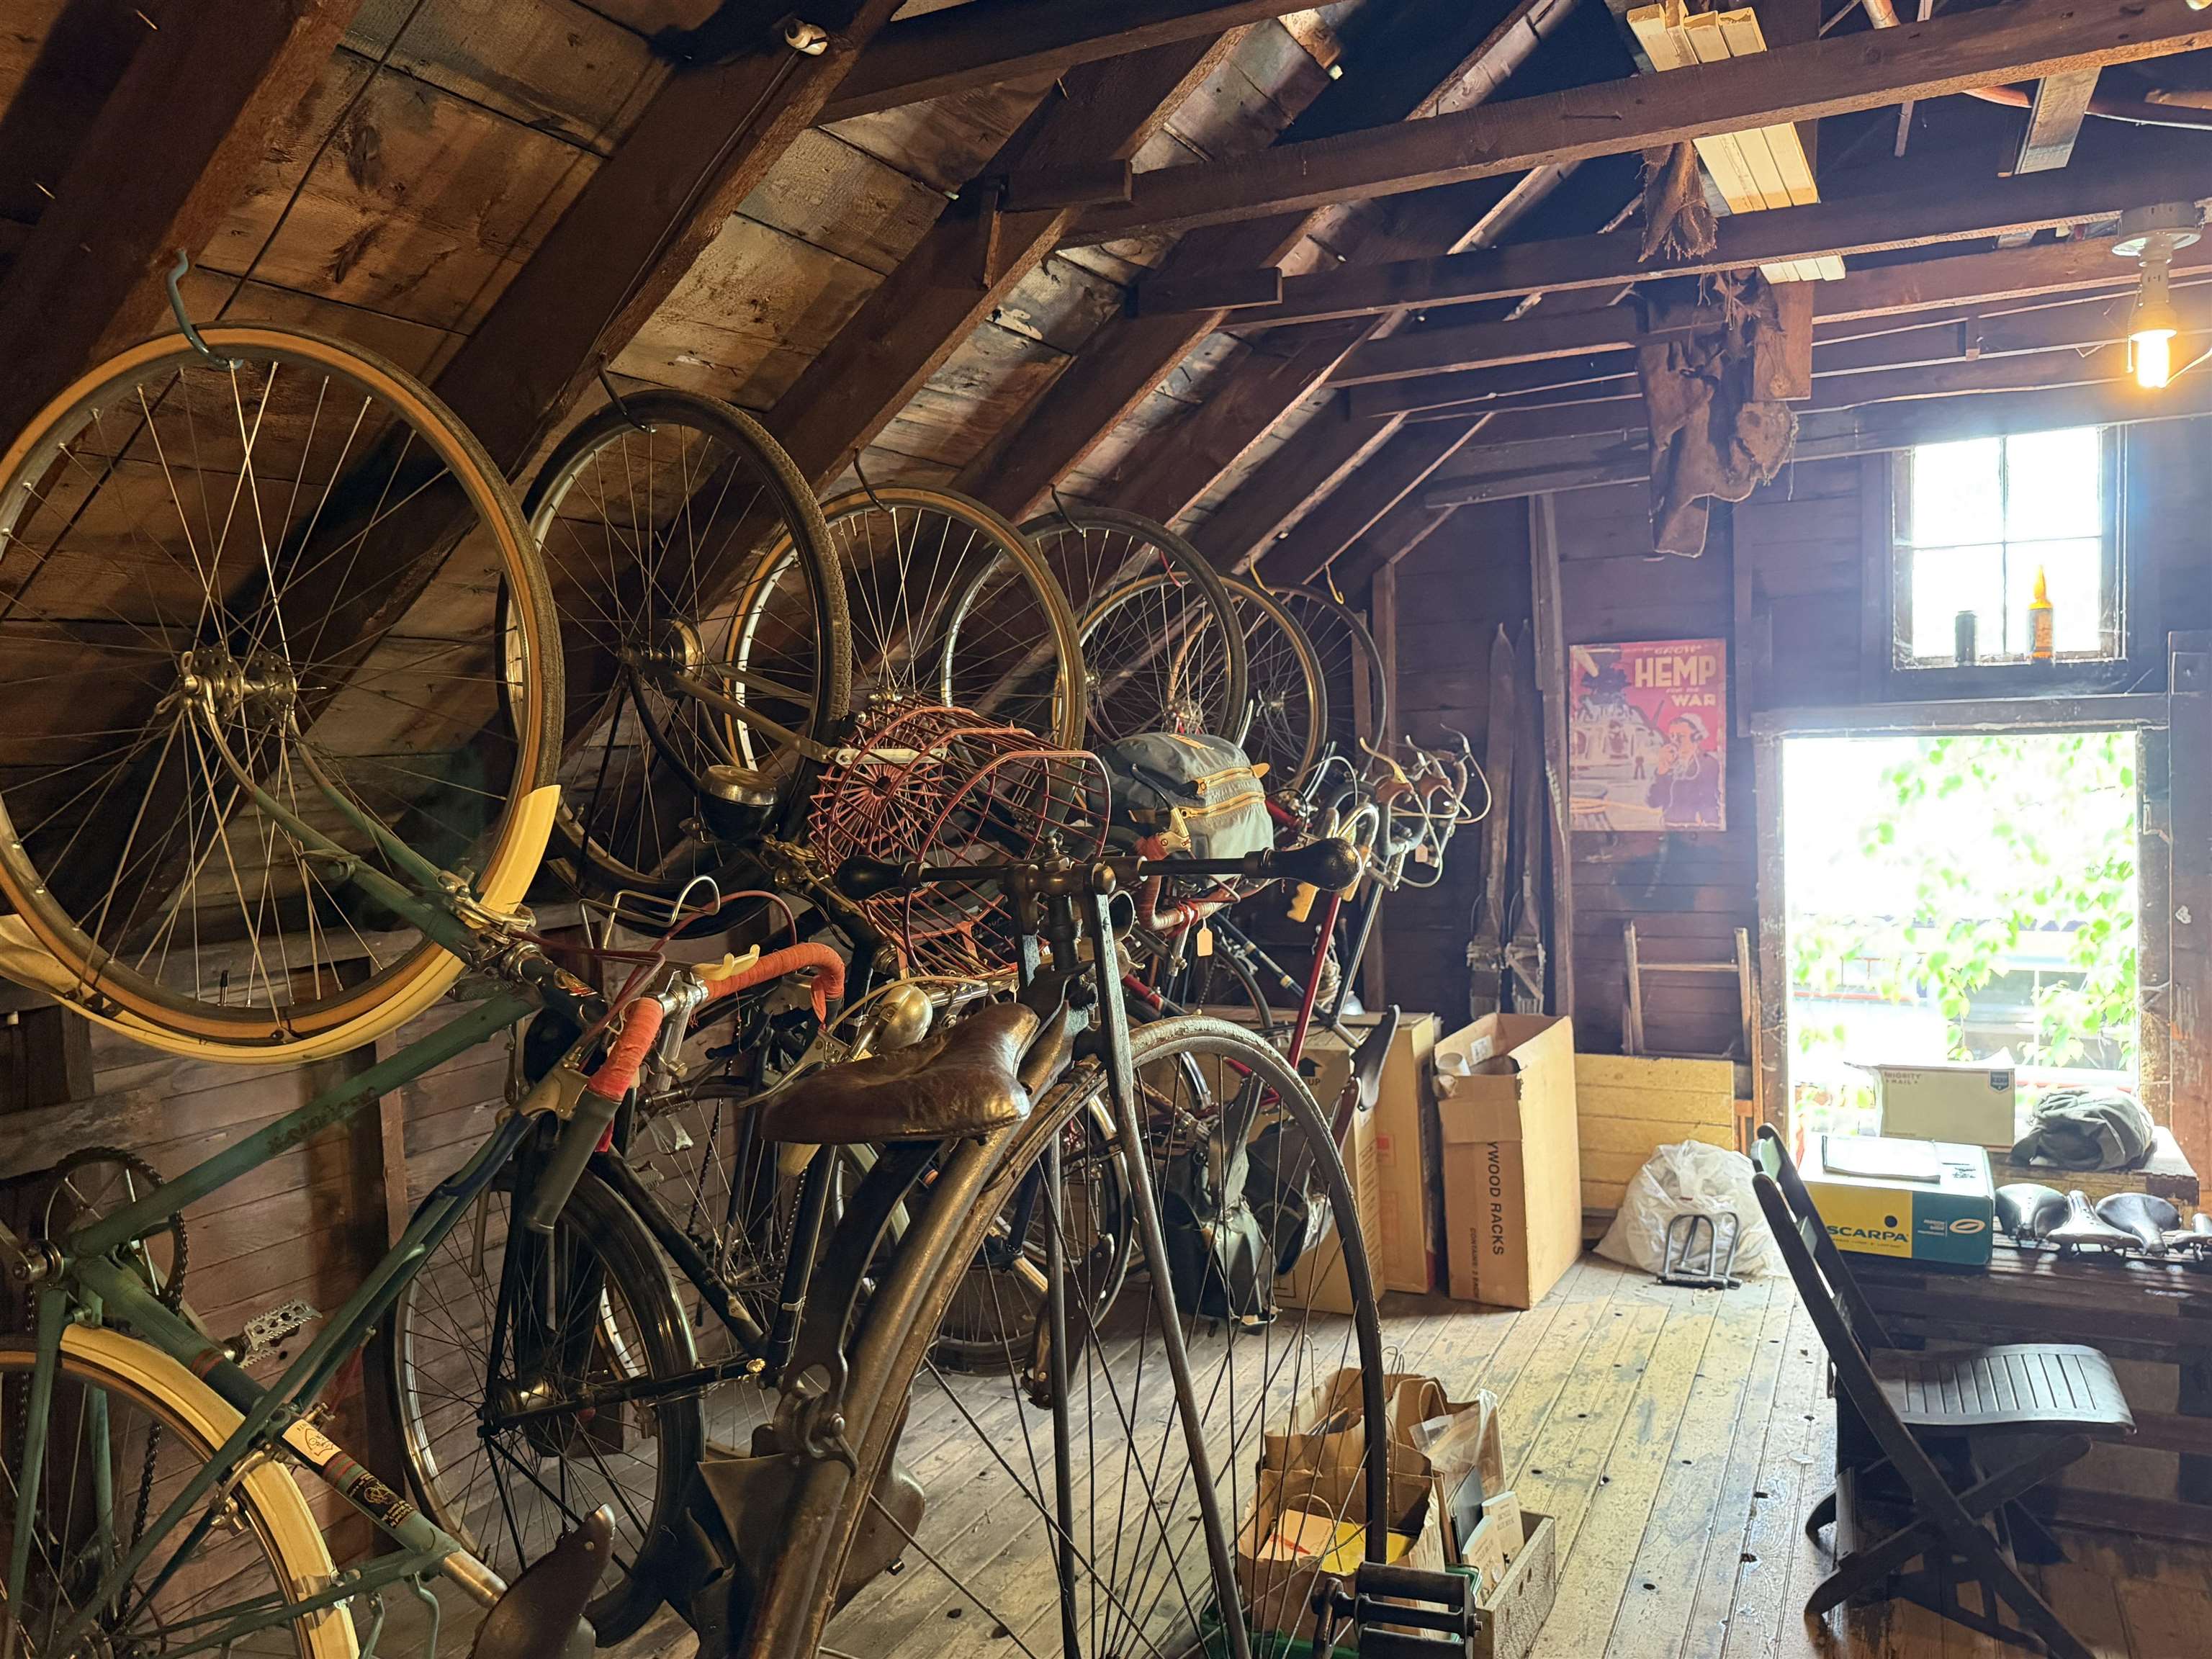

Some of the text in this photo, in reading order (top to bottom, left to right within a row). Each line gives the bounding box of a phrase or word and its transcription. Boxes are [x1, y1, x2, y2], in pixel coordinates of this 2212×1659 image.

[1635, 656, 1717, 688] HEMP
[1671, 693, 1716, 706] WAR
[1490, 1202, 1505, 1256] RACKS
[1826, 1225, 1909, 1243] SCARPA
